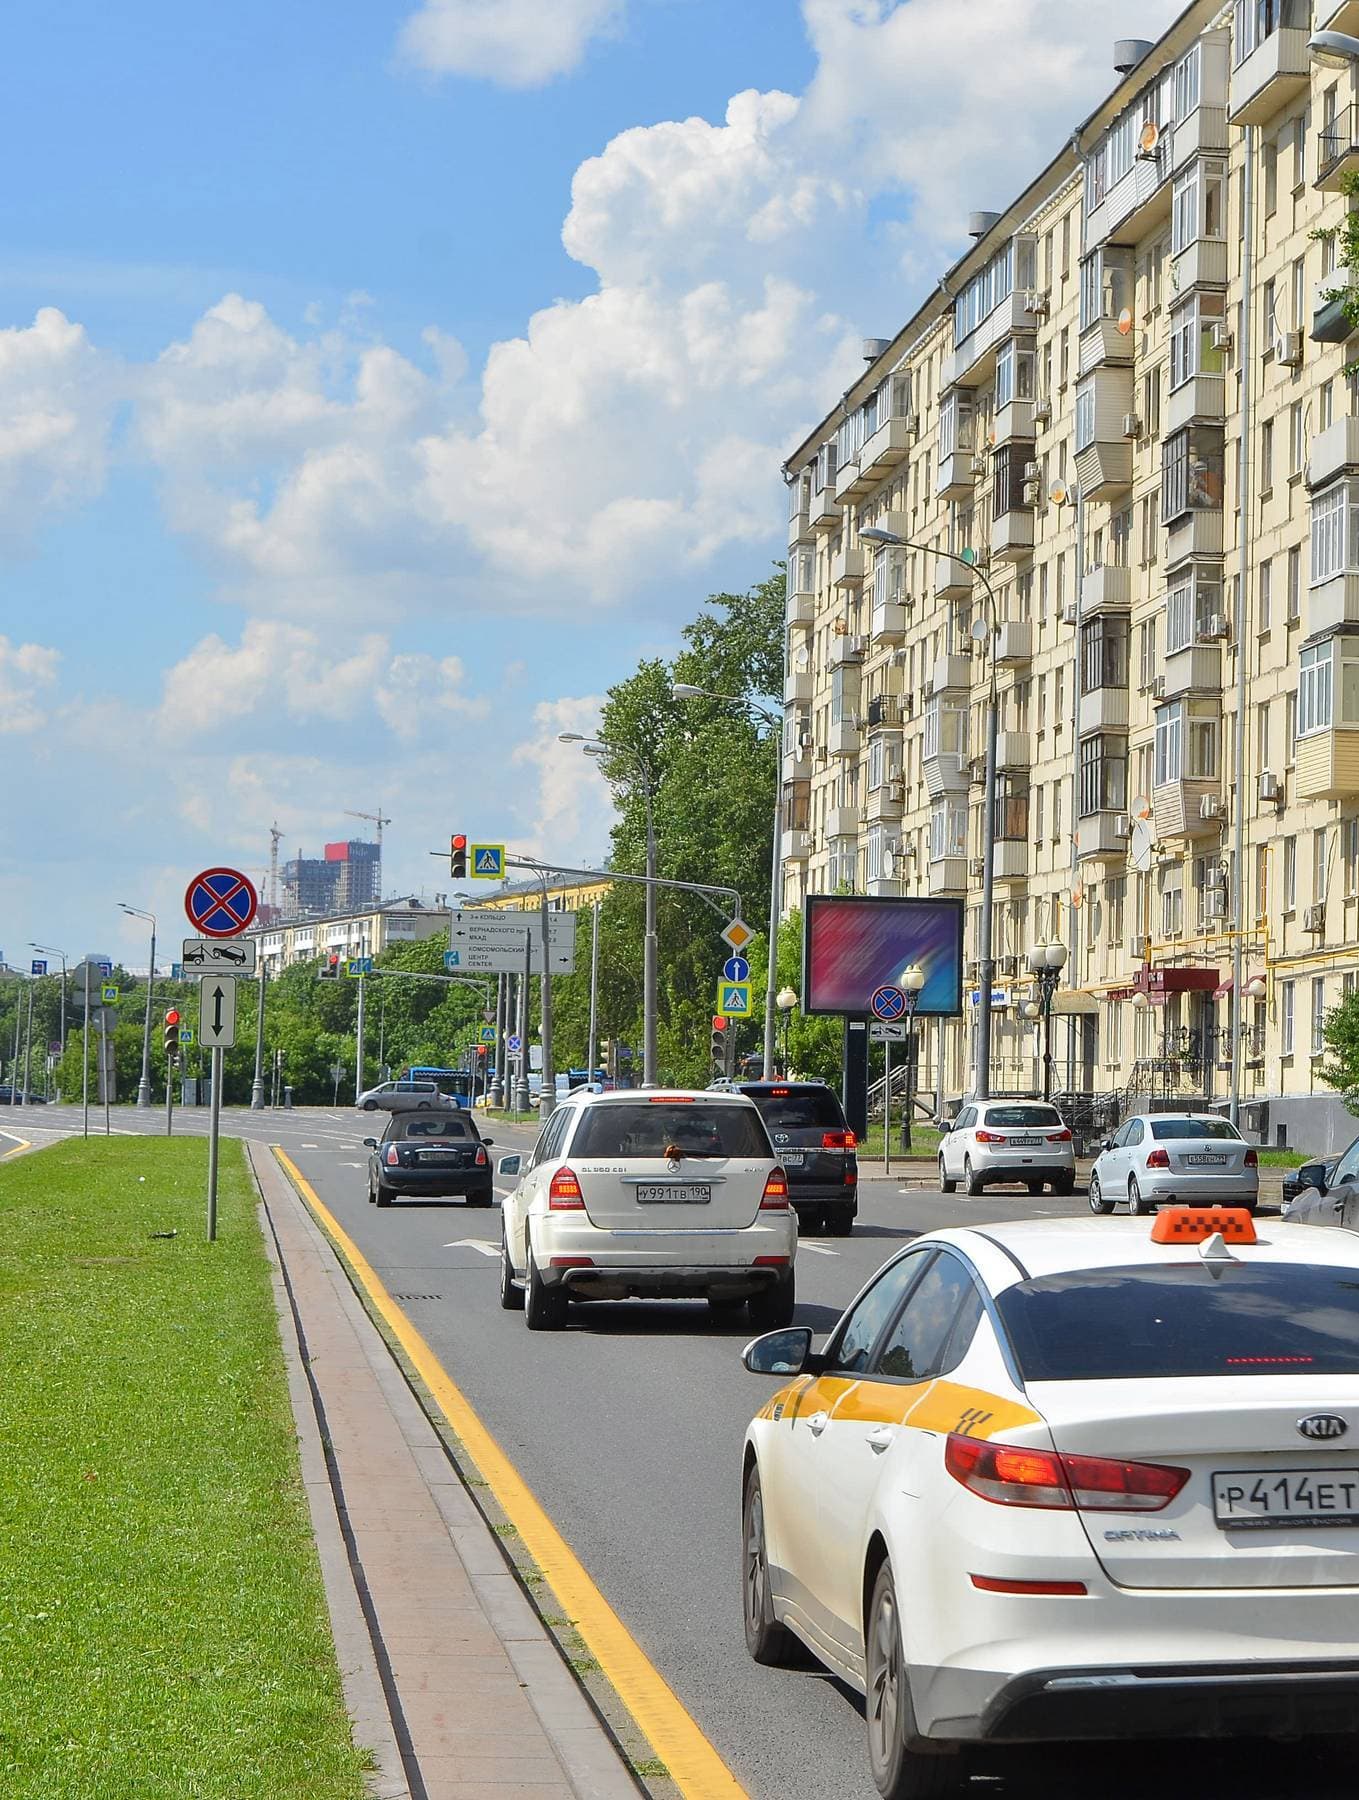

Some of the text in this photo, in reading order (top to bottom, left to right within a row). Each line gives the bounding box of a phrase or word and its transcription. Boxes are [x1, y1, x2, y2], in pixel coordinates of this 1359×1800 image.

[642, 1188, 687, 1200] У991ТВ
[1306, 1419, 1342, 1435] KIA
[1227, 1477, 1356, 1512] Р414ЕТ
